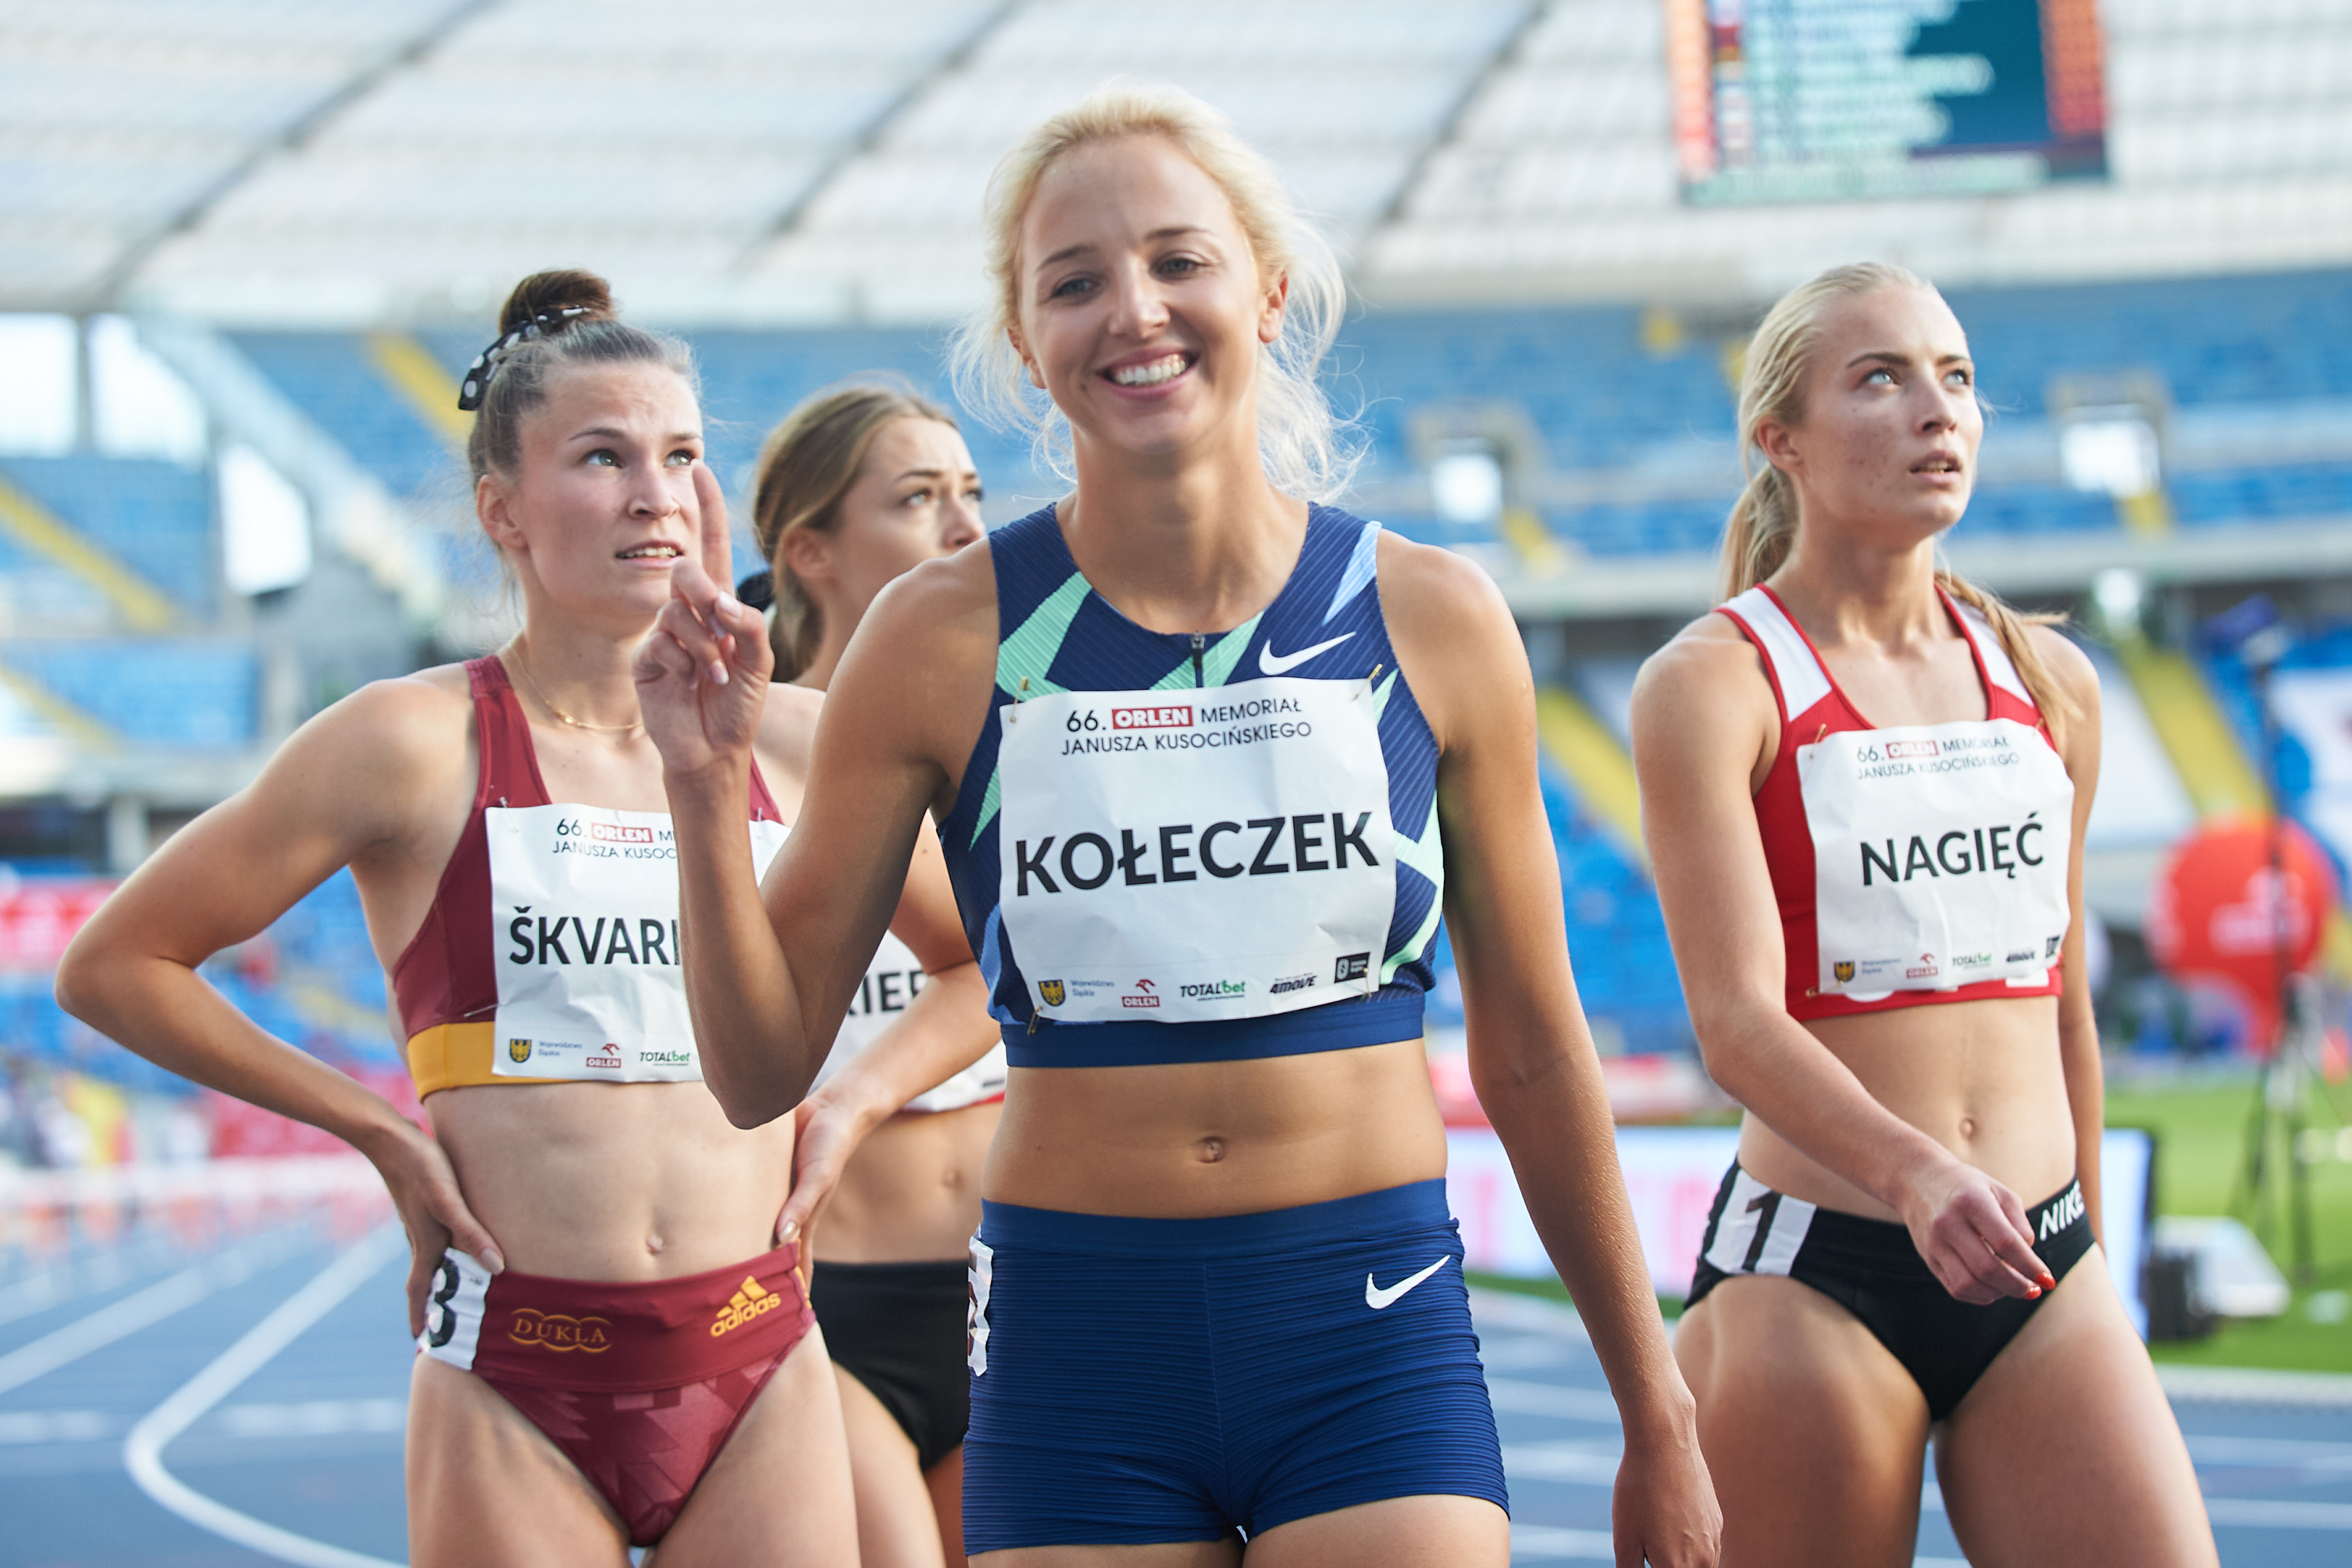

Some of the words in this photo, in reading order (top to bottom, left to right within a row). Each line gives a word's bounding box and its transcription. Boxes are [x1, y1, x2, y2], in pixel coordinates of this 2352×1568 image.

[1067, 710, 1106, 732] 66.
[1115, 708, 1192, 728] ORLEN
[1201, 698, 1302, 723] MEMORIAŁ
[1062, 736, 1148, 755] JANUSZA
[1155, 722, 1311, 750] KUSOCIŃSKIEGO
[1857, 745, 1885, 762] 66.
[1942, 736, 2010, 752] MEMORIAŁ
[1858, 762, 1916, 779] JANUSZA
[557, 819, 587, 838] 66.
[593, 825, 651, 842] ORLEN
[553, 841, 619, 858] JANUSZA
[1016, 811, 1379, 896] KOŁECZEK
[1860, 811, 2044, 887] NAGIĘĆ
[1181, 980, 1245, 997] TOTALbet
[1124, 997, 1158, 1007] ORLEN
[587, 1058, 620, 1067] ORLEN
[640, 1050, 690, 1062] TOTALbet
[2040, 1179, 2085, 1241] NIKE
[1742, 1190, 1783, 1271] 1
[710, 1292, 781, 1337] adidas
[514, 1318, 607, 1343] DUKLA
